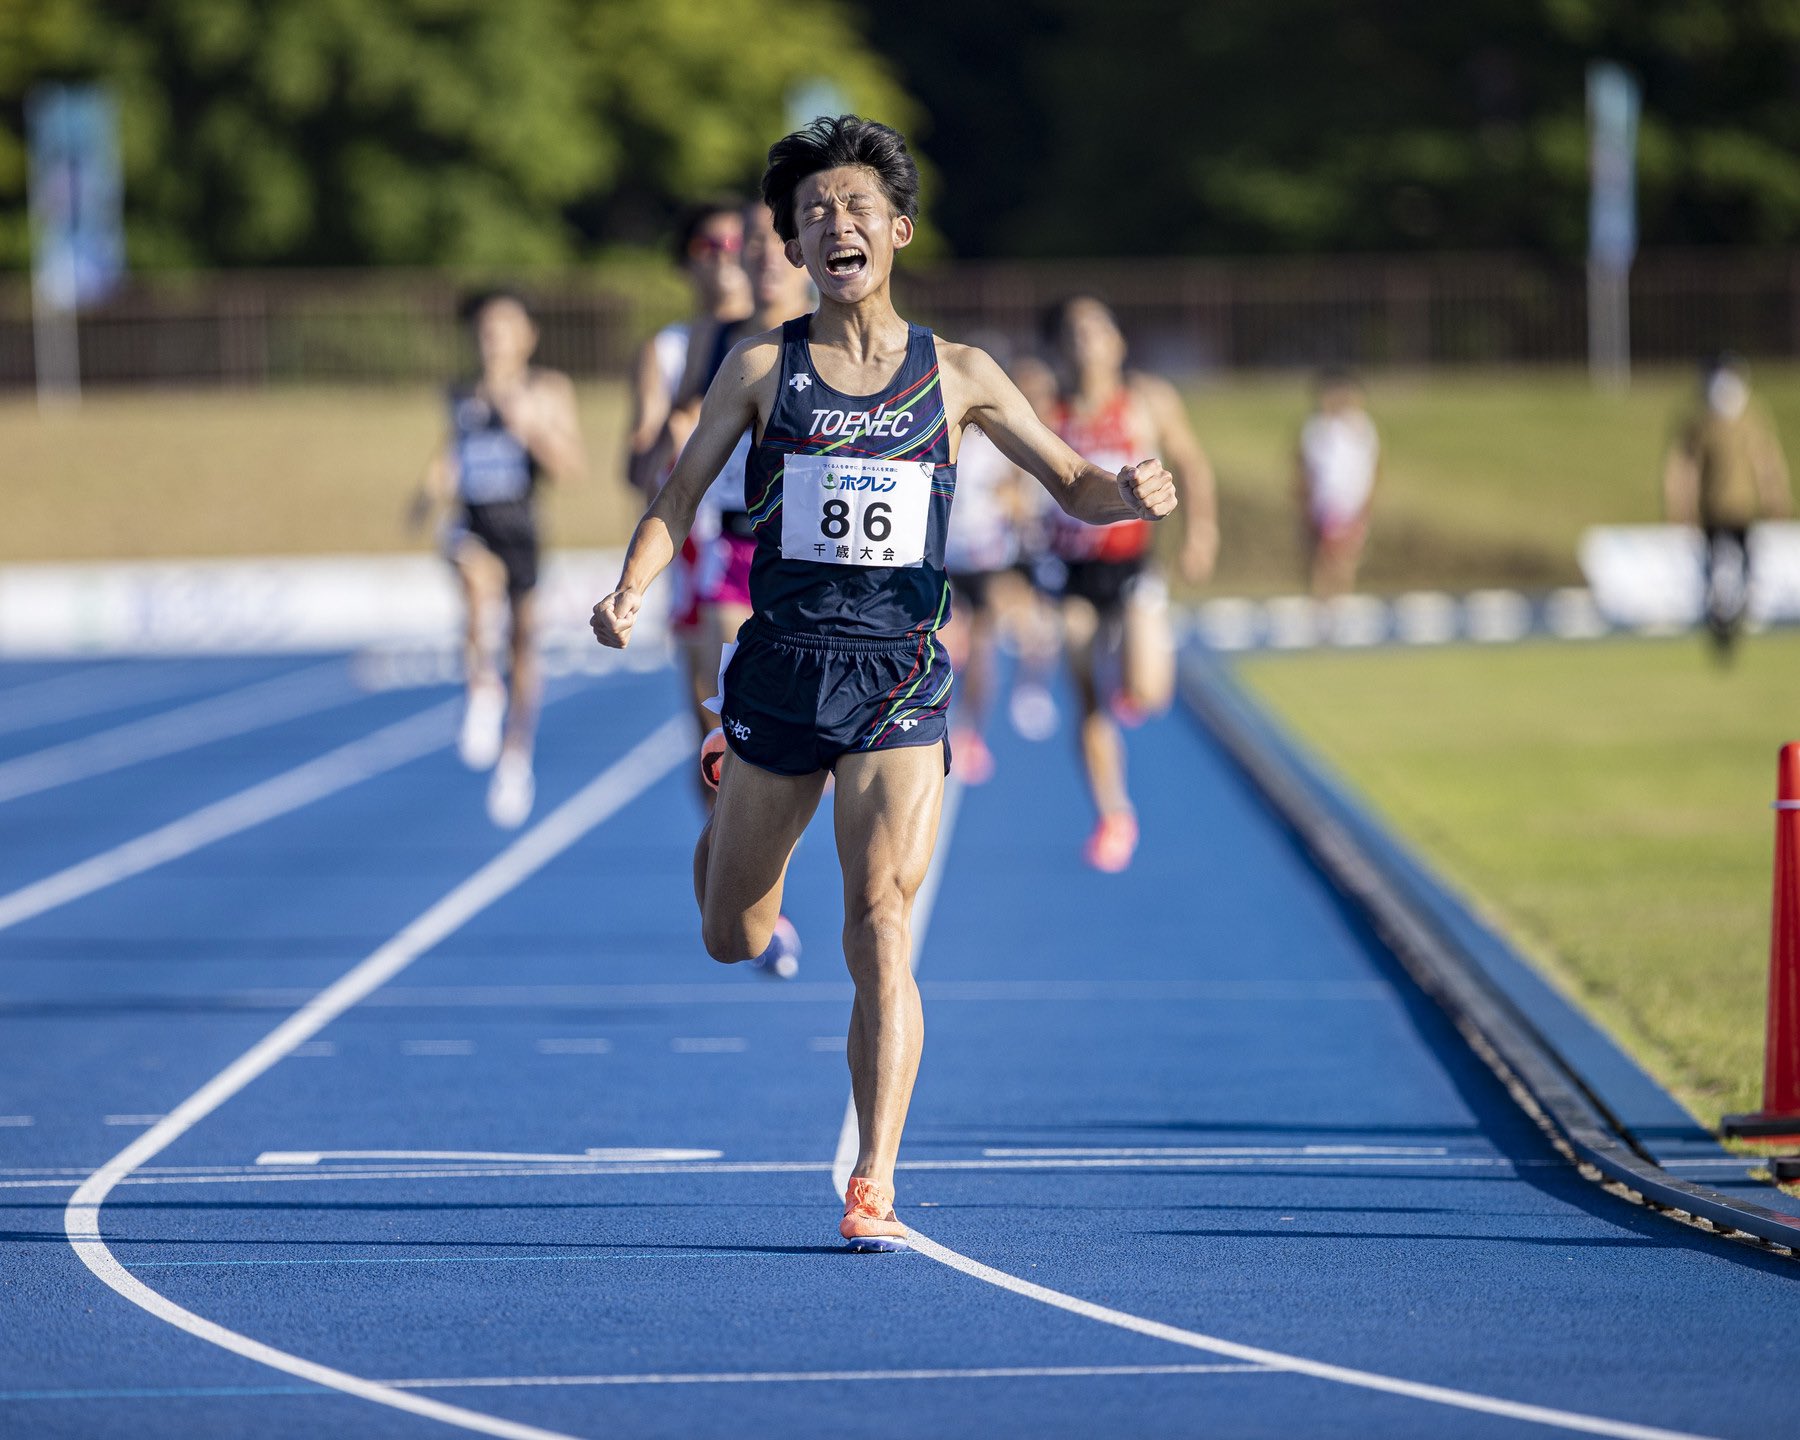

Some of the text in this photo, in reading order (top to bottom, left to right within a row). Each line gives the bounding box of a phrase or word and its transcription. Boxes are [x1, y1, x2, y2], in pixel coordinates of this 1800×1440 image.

[809, 403, 914, 444] TOENEC
[839, 475, 897, 493] ホクレン
[820, 499, 893, 542] 86
[813, 543, 895, 562] 千歳大会
